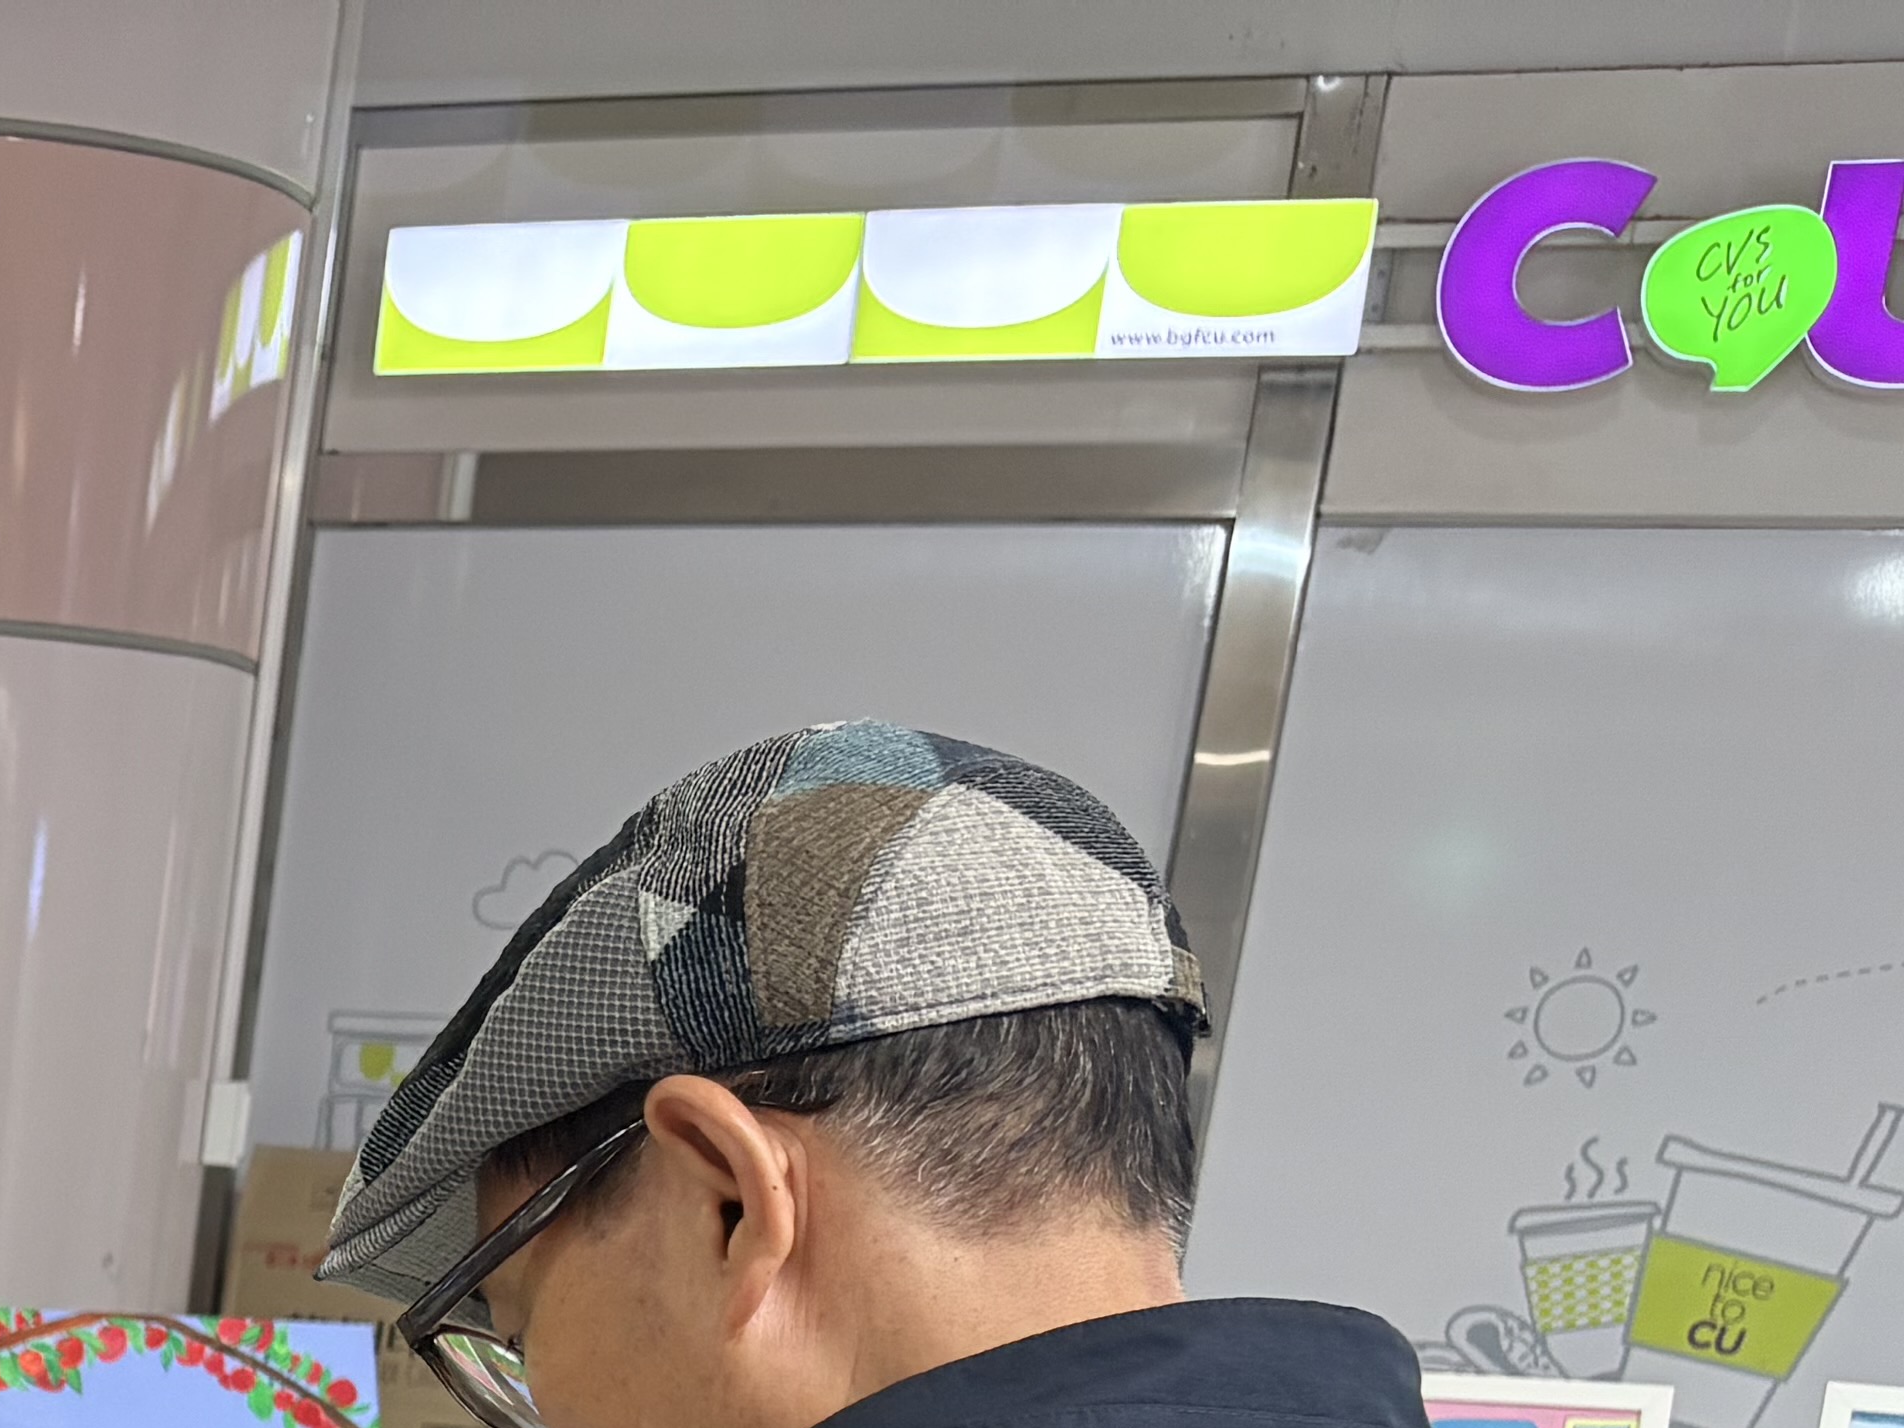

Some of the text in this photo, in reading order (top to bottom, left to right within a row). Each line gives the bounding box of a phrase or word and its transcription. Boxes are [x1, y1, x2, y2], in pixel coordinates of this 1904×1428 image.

[1695, 224, 1772, 283] CVS
[1727, 264, 1771, 294] for
[1701, 275, 1790, 342] YOU
[1110, 325, 1276, 348] www.bgfcu.com
[1701, 1260, 1775, 1302] nice
[1710, 1292, 1746, 1326] to
[1687, 1319, 1748, 1356] CU
